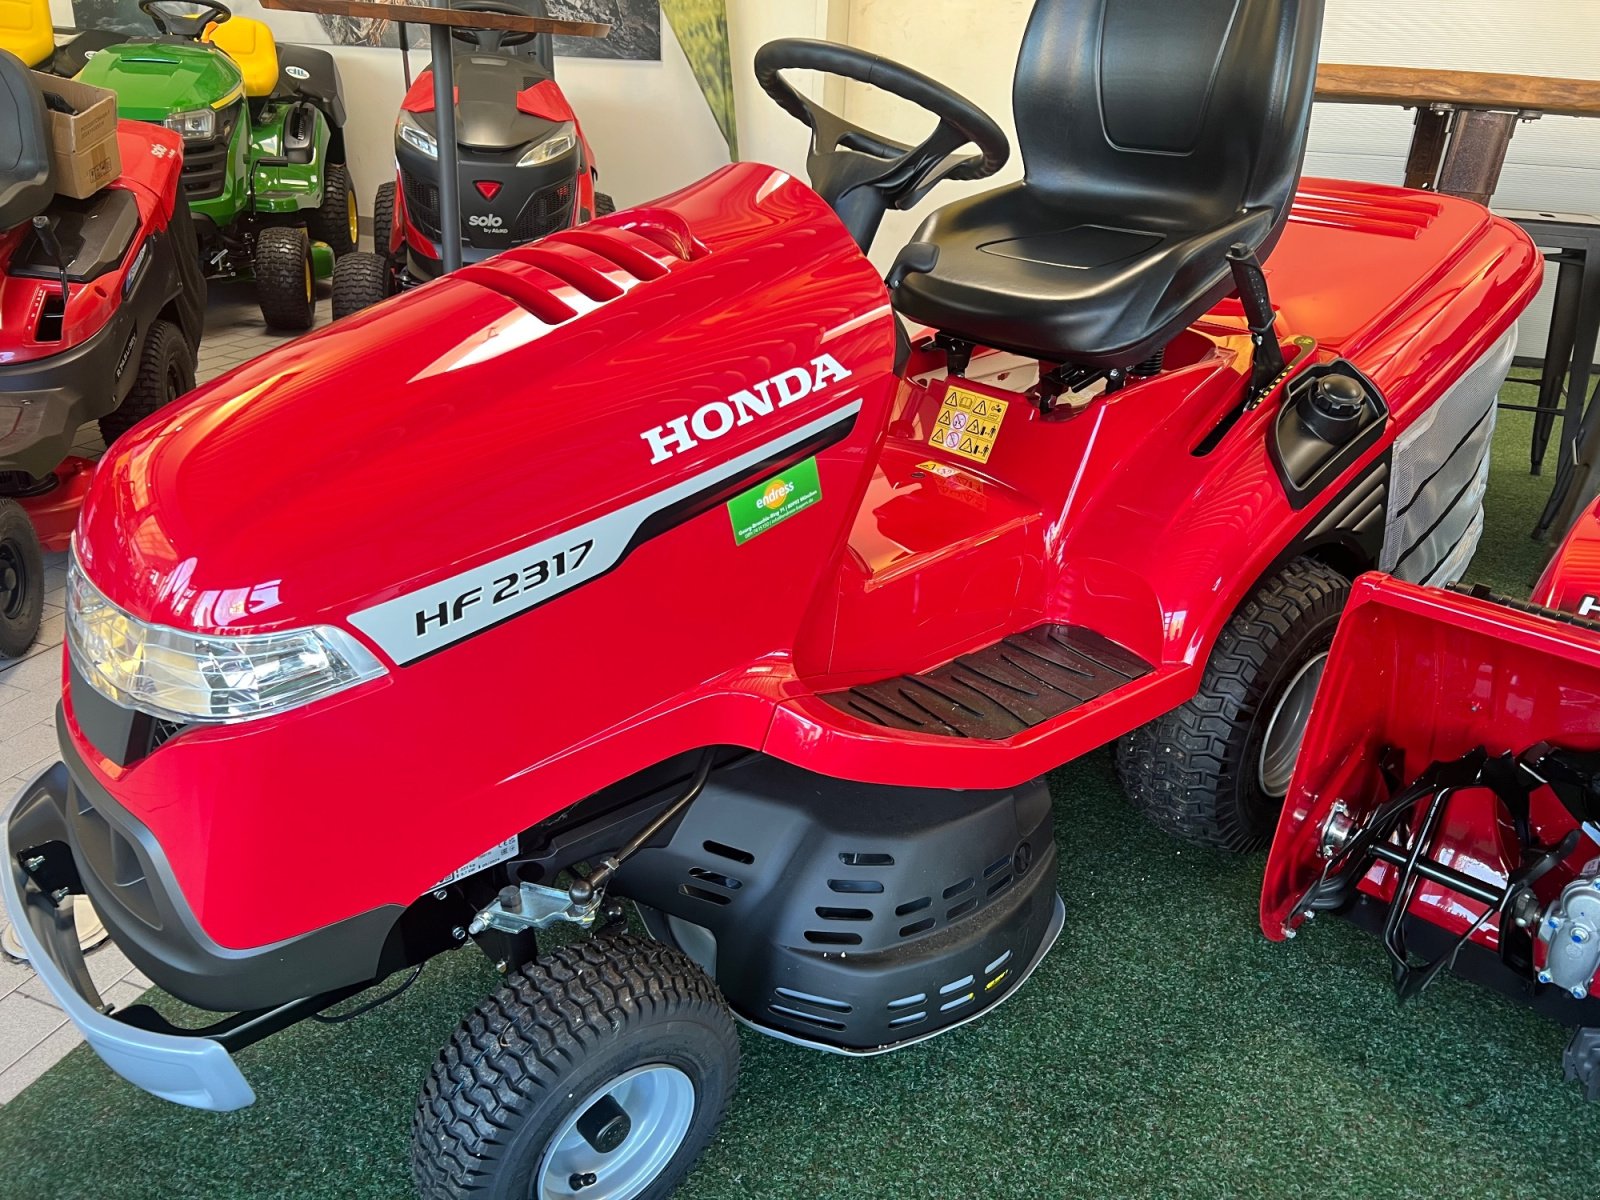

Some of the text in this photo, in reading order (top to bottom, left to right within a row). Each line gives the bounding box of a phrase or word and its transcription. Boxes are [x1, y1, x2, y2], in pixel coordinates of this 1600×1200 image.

[468, 213, 503, 227] solo
[640, 353, 853, 465] HONDA
[755, 481, 795, 509] endress
[415, 538, 595, 637] HF 2317
